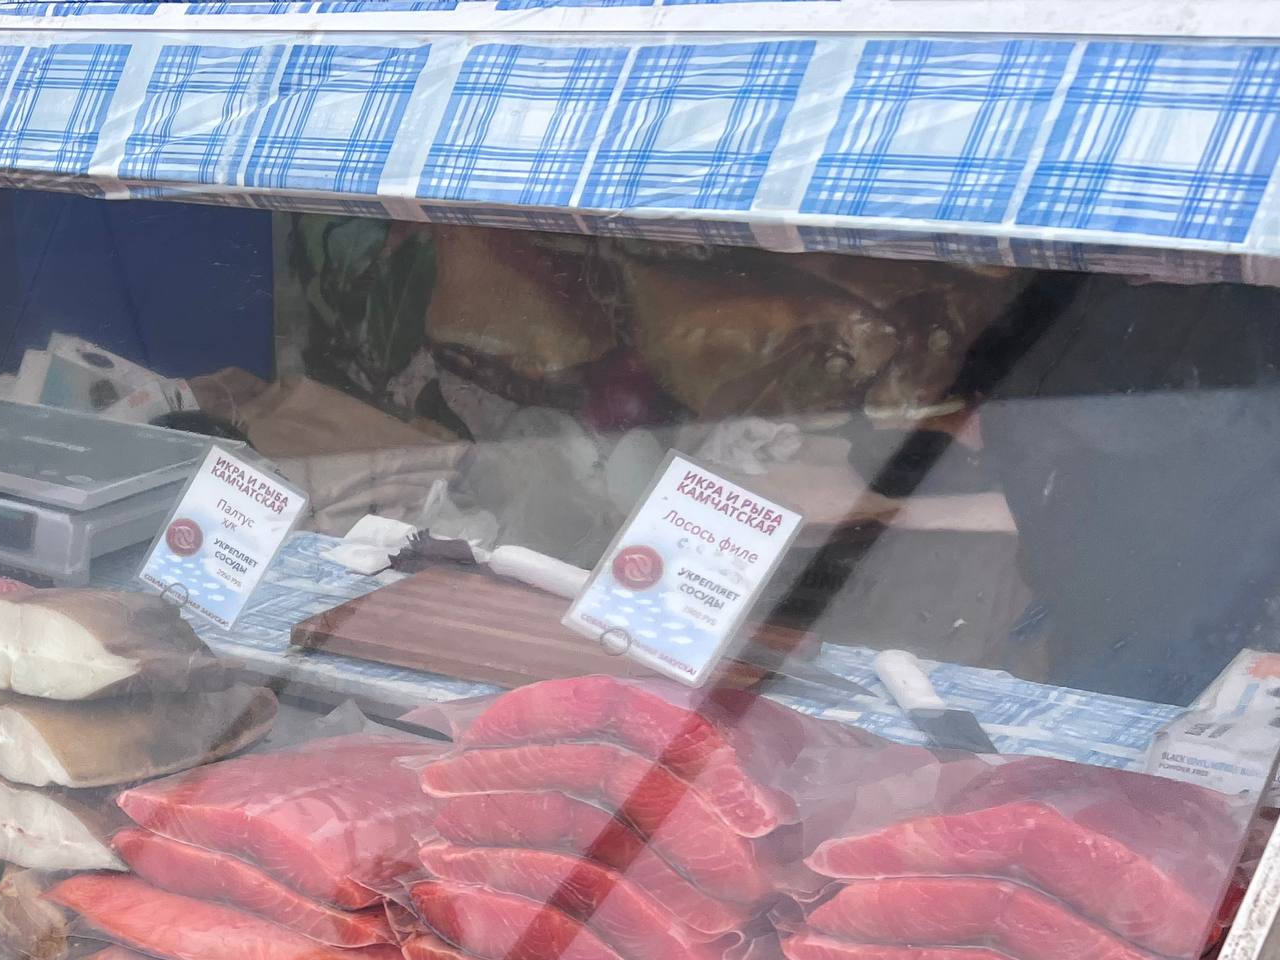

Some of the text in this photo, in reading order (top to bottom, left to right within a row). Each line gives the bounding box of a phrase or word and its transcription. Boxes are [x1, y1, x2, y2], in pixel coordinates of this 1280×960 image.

[209, 465, 285, 514] КАМЧАТСКАЯ
[214, 456, 291, 507] ИКРА И РЫБА
[681, 470, 785, 526] ИКРА И РЫБА
[214, 498, 257, 530] Палтус
[674, 480, 778, 536] КАМЧАТСКАЯ
[212, 537, 259, 568] УКРЕПЛЯЕТ
[661, 507, 720, 544] Лосось
[715, 534, 762, 566] филе
[212, 549, 248, 575] СОСУДЫ
[676, 566, 740, 604] УКРЕПЛЯЕТ
[677, 581, 725, 611] СОСУДЫ
